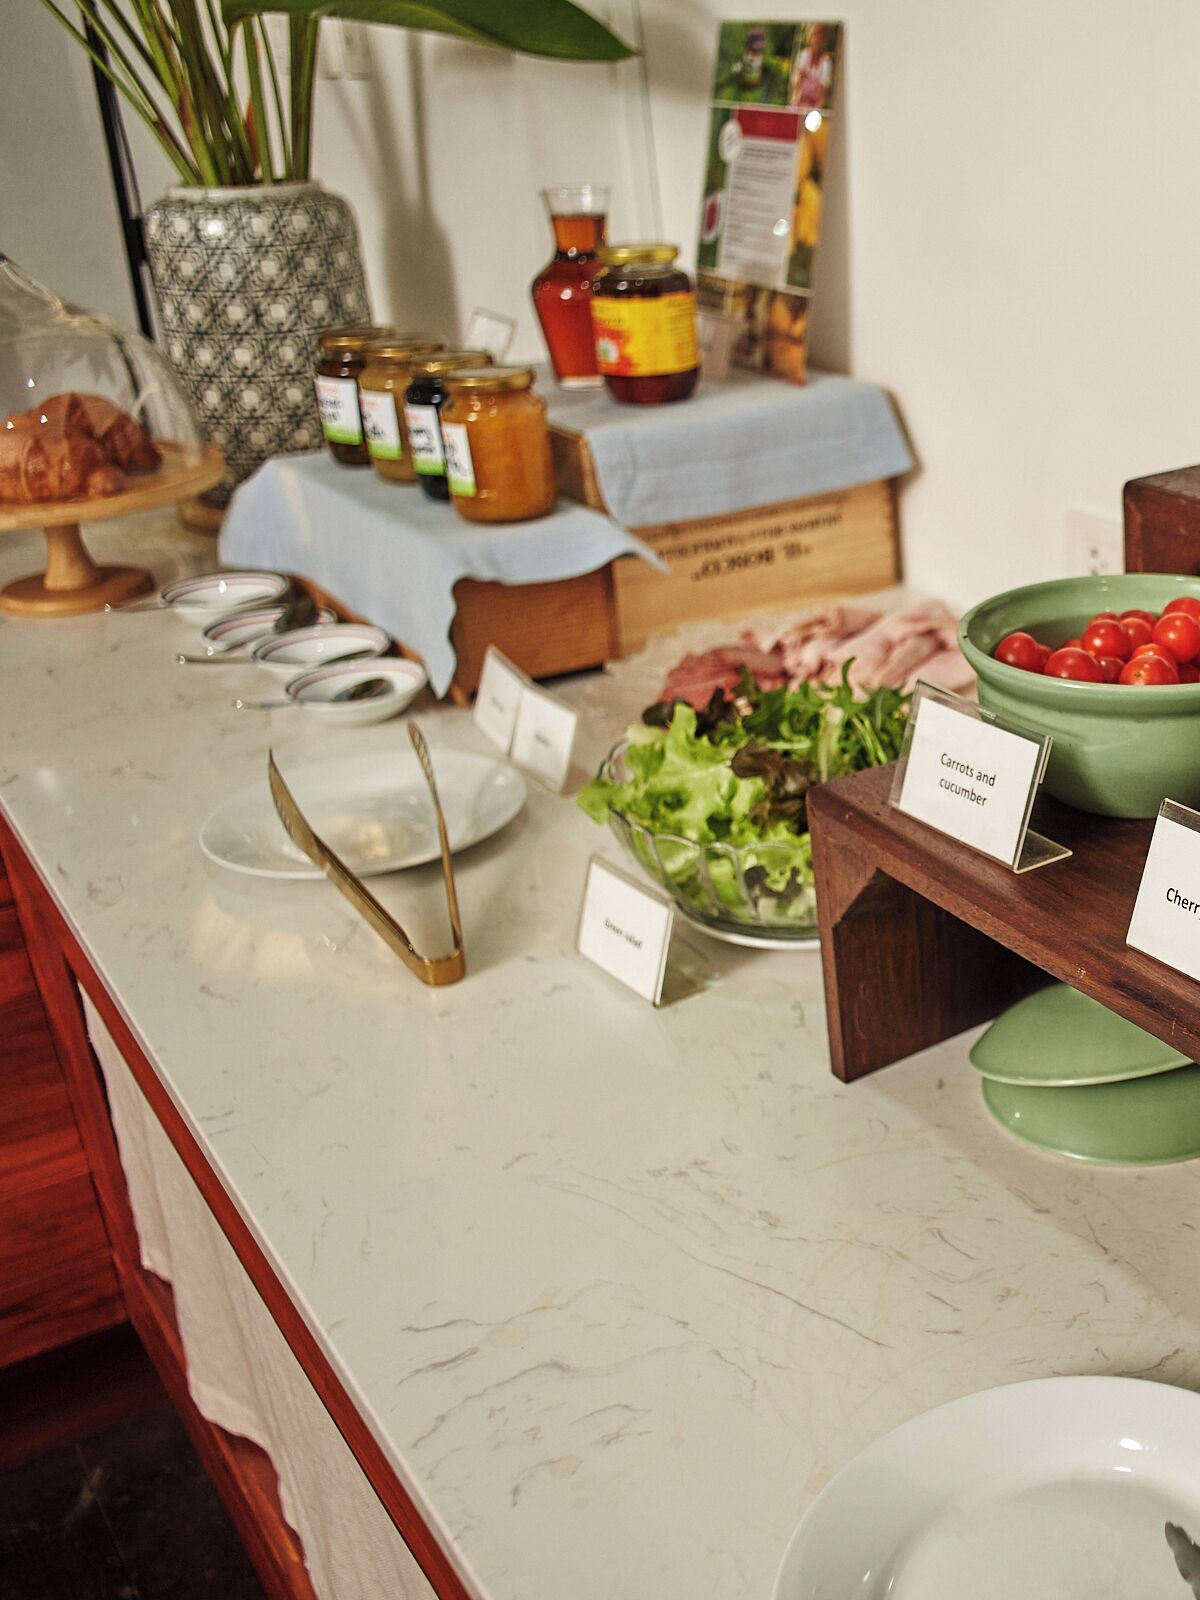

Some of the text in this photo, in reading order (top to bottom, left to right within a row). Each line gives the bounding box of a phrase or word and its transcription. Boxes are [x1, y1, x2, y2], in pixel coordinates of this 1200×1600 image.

[940, 751, 997, 788] Carrots and
[938, 776, 989, 808] cucumber
